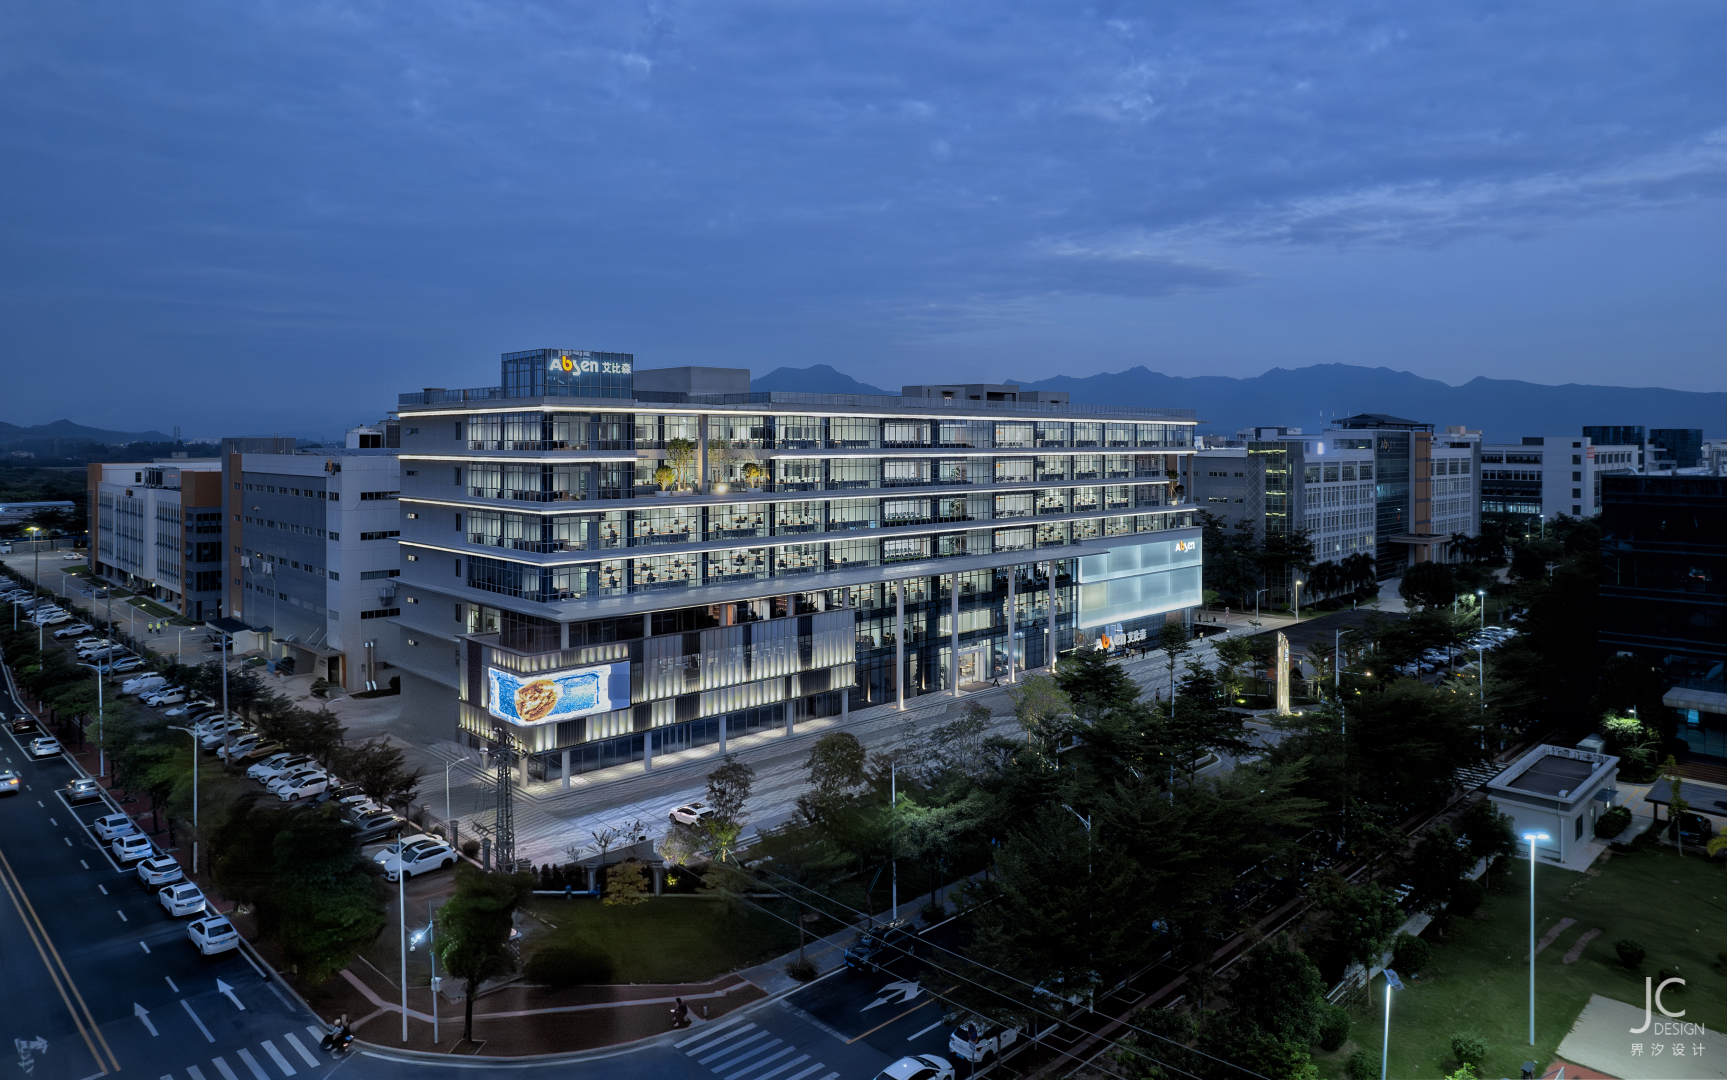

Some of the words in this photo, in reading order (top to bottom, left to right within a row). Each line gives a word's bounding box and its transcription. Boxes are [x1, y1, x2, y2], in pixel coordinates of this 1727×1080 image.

[549, 356, 599, 376] Absen
[602, 362, 631, 374] 艾比森
[1175, 540, 1196, 553] Absen
[1093, 633, 1127, 652] Absen
